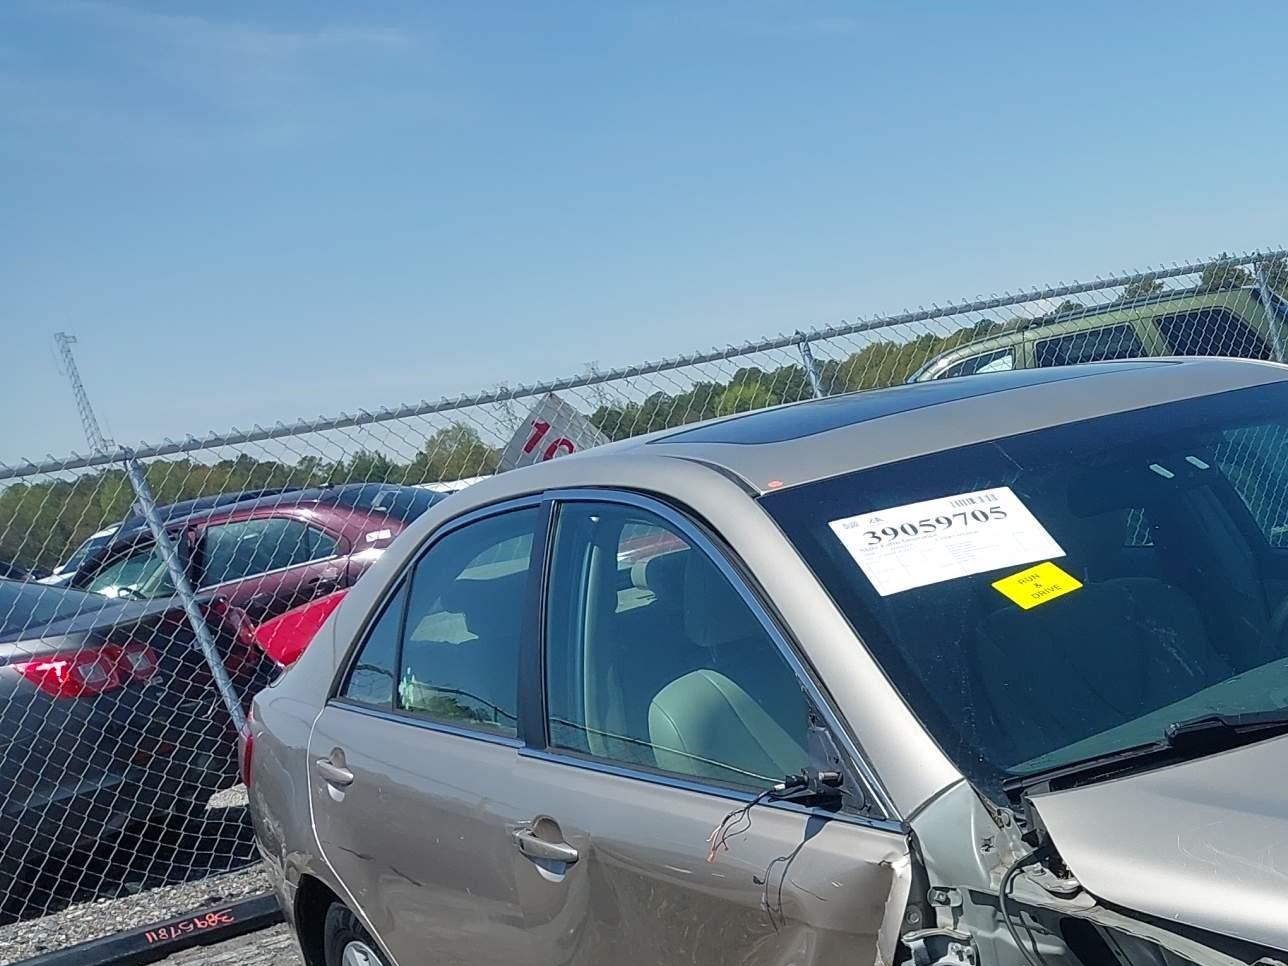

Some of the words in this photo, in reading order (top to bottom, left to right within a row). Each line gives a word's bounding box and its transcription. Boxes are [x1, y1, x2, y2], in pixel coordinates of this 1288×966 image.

[863, 506, 1008, 546] 39059705
[1017, 573, 1040, 585] RUN
[1031, 584, 1062, 600] DRIVE
